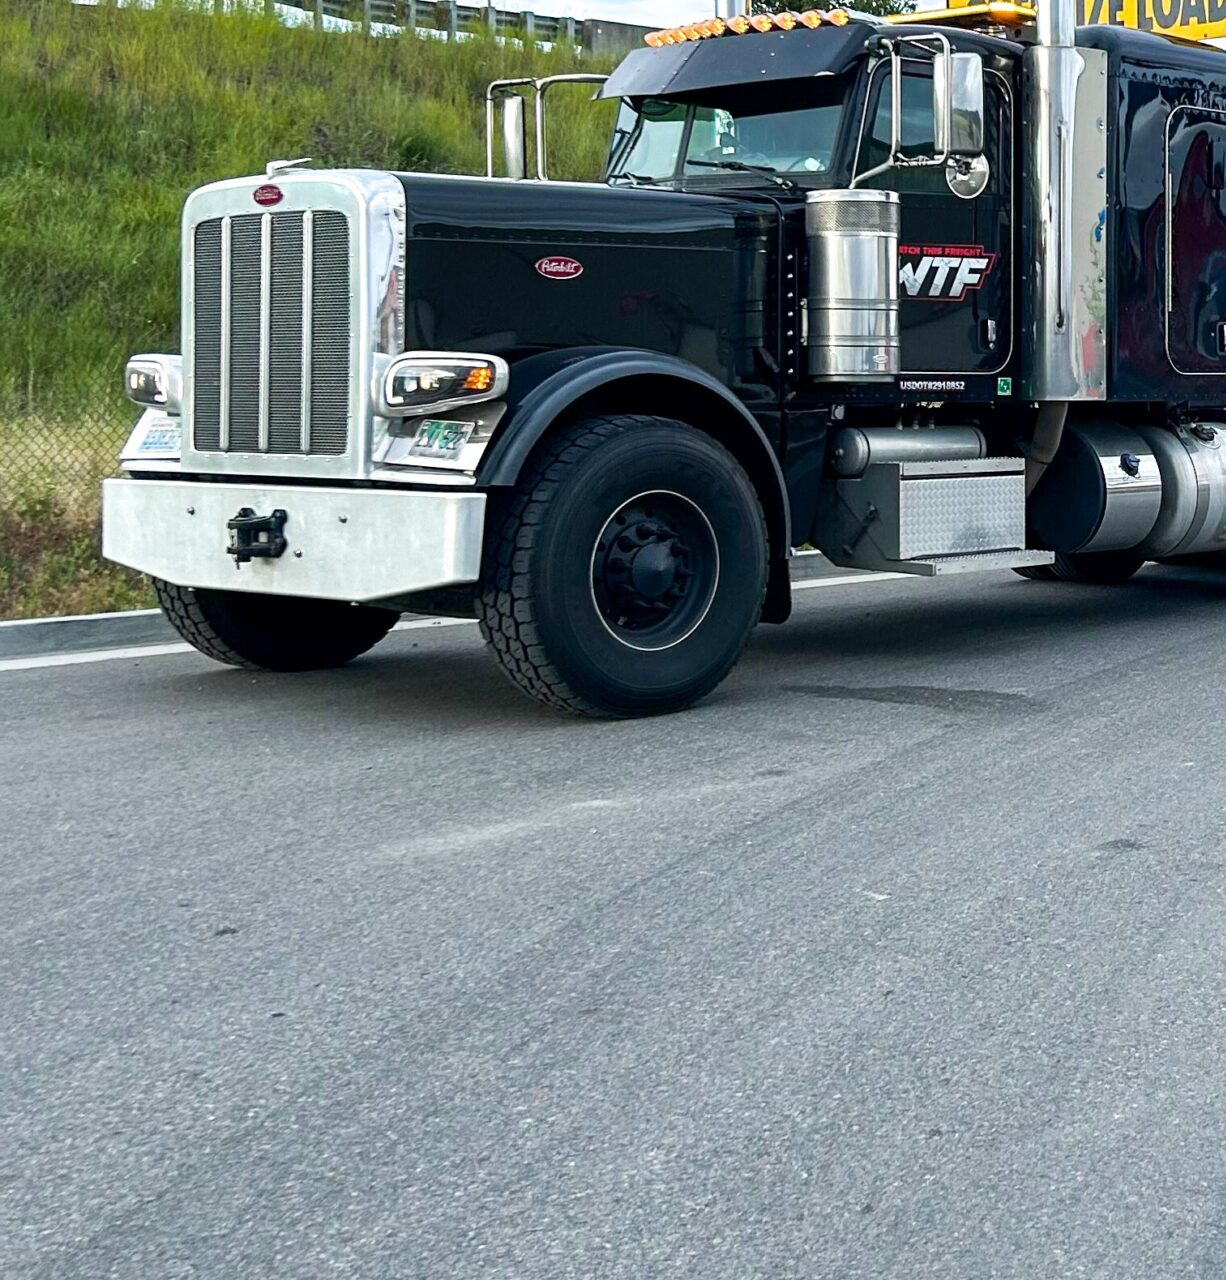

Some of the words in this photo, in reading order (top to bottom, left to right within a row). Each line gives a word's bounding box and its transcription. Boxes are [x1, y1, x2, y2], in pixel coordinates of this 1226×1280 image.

[923, 247, 943, 255] THIS
[945, 248, 981, 256] FREIGHT
[541, 260, 579, 273] Peterbilt
[899, 256, 989, 297] WTF
